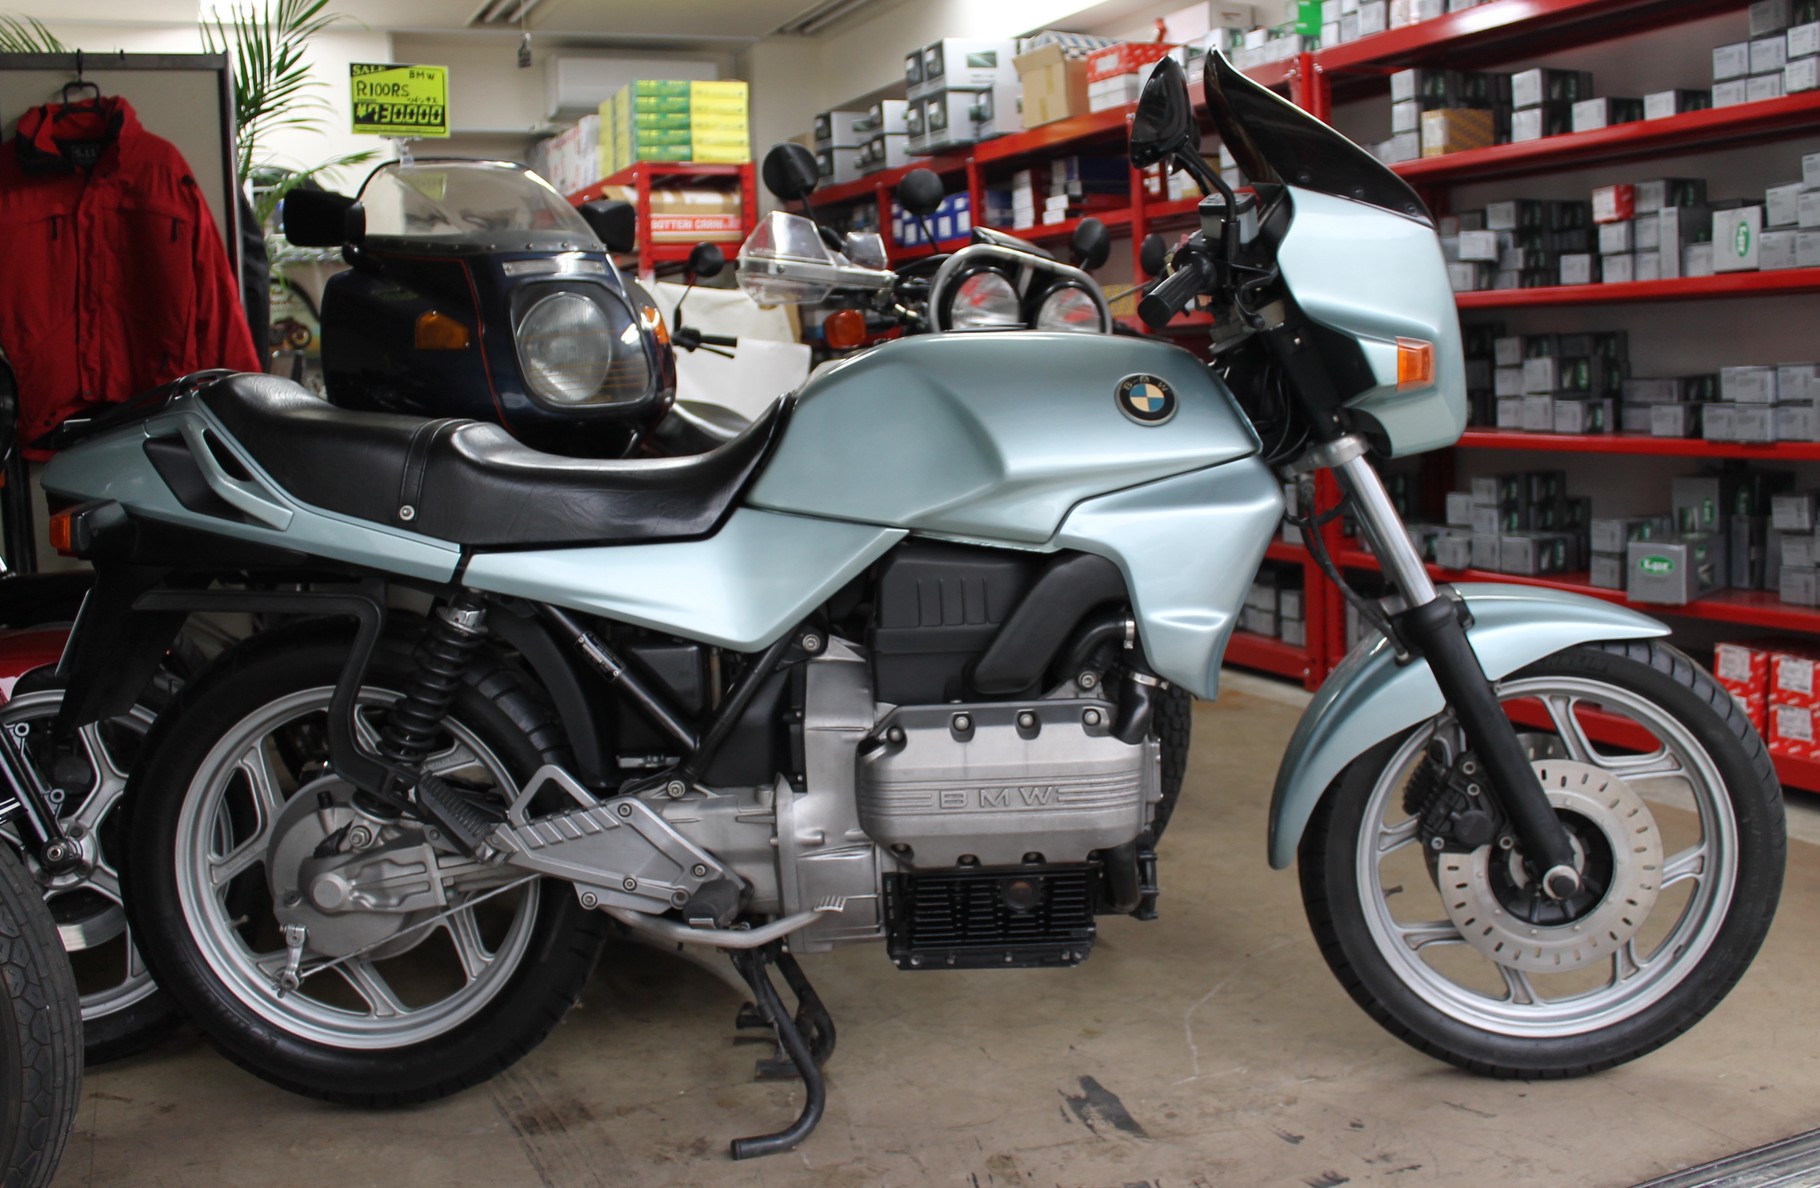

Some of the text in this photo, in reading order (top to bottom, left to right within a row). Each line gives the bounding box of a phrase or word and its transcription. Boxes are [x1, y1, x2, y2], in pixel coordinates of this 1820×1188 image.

[409, 70, 435, 80] BMW
[356, 80, 410, 97] R100RS
[1123, 376, 1168, 391] BMW
[940, 786, 1053, 809] BMW
